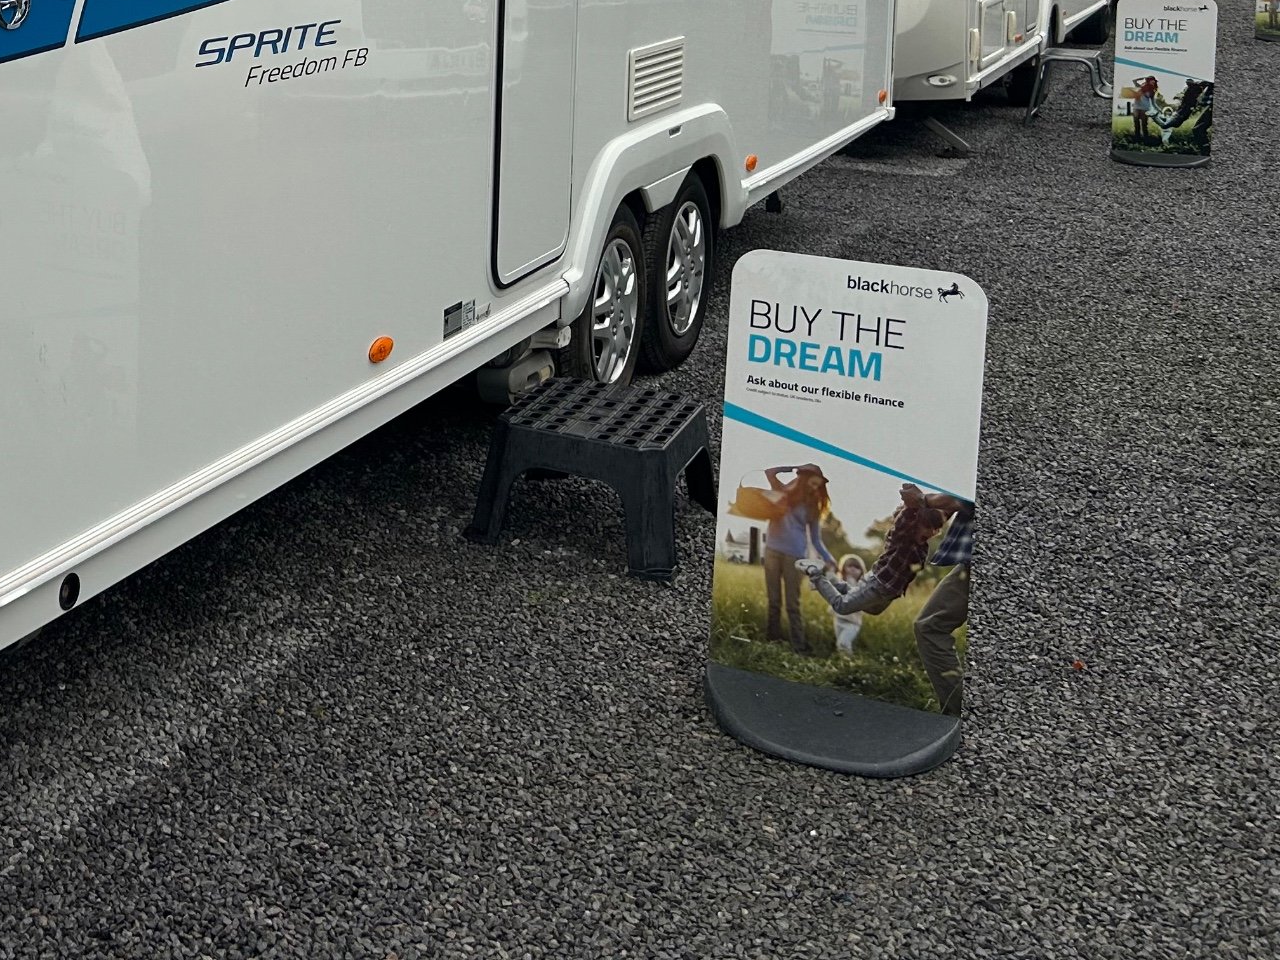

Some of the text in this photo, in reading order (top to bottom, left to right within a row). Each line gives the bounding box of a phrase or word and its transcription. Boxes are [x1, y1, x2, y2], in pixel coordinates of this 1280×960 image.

[195, 19, 342, 68] SPRITE
[1124, 17, 1188, 32] BUY THE
[1124, 30, 1179, 44] DREAM
[245, 47, 369, 88] Freedom FB
[847, 275, 933, 299] blackhorse
[749, 299, 907, 350] BUY THE
[747, 333, 883, 382] DREAM
[746, 374, 906, 409] Ask about our flexible finance
